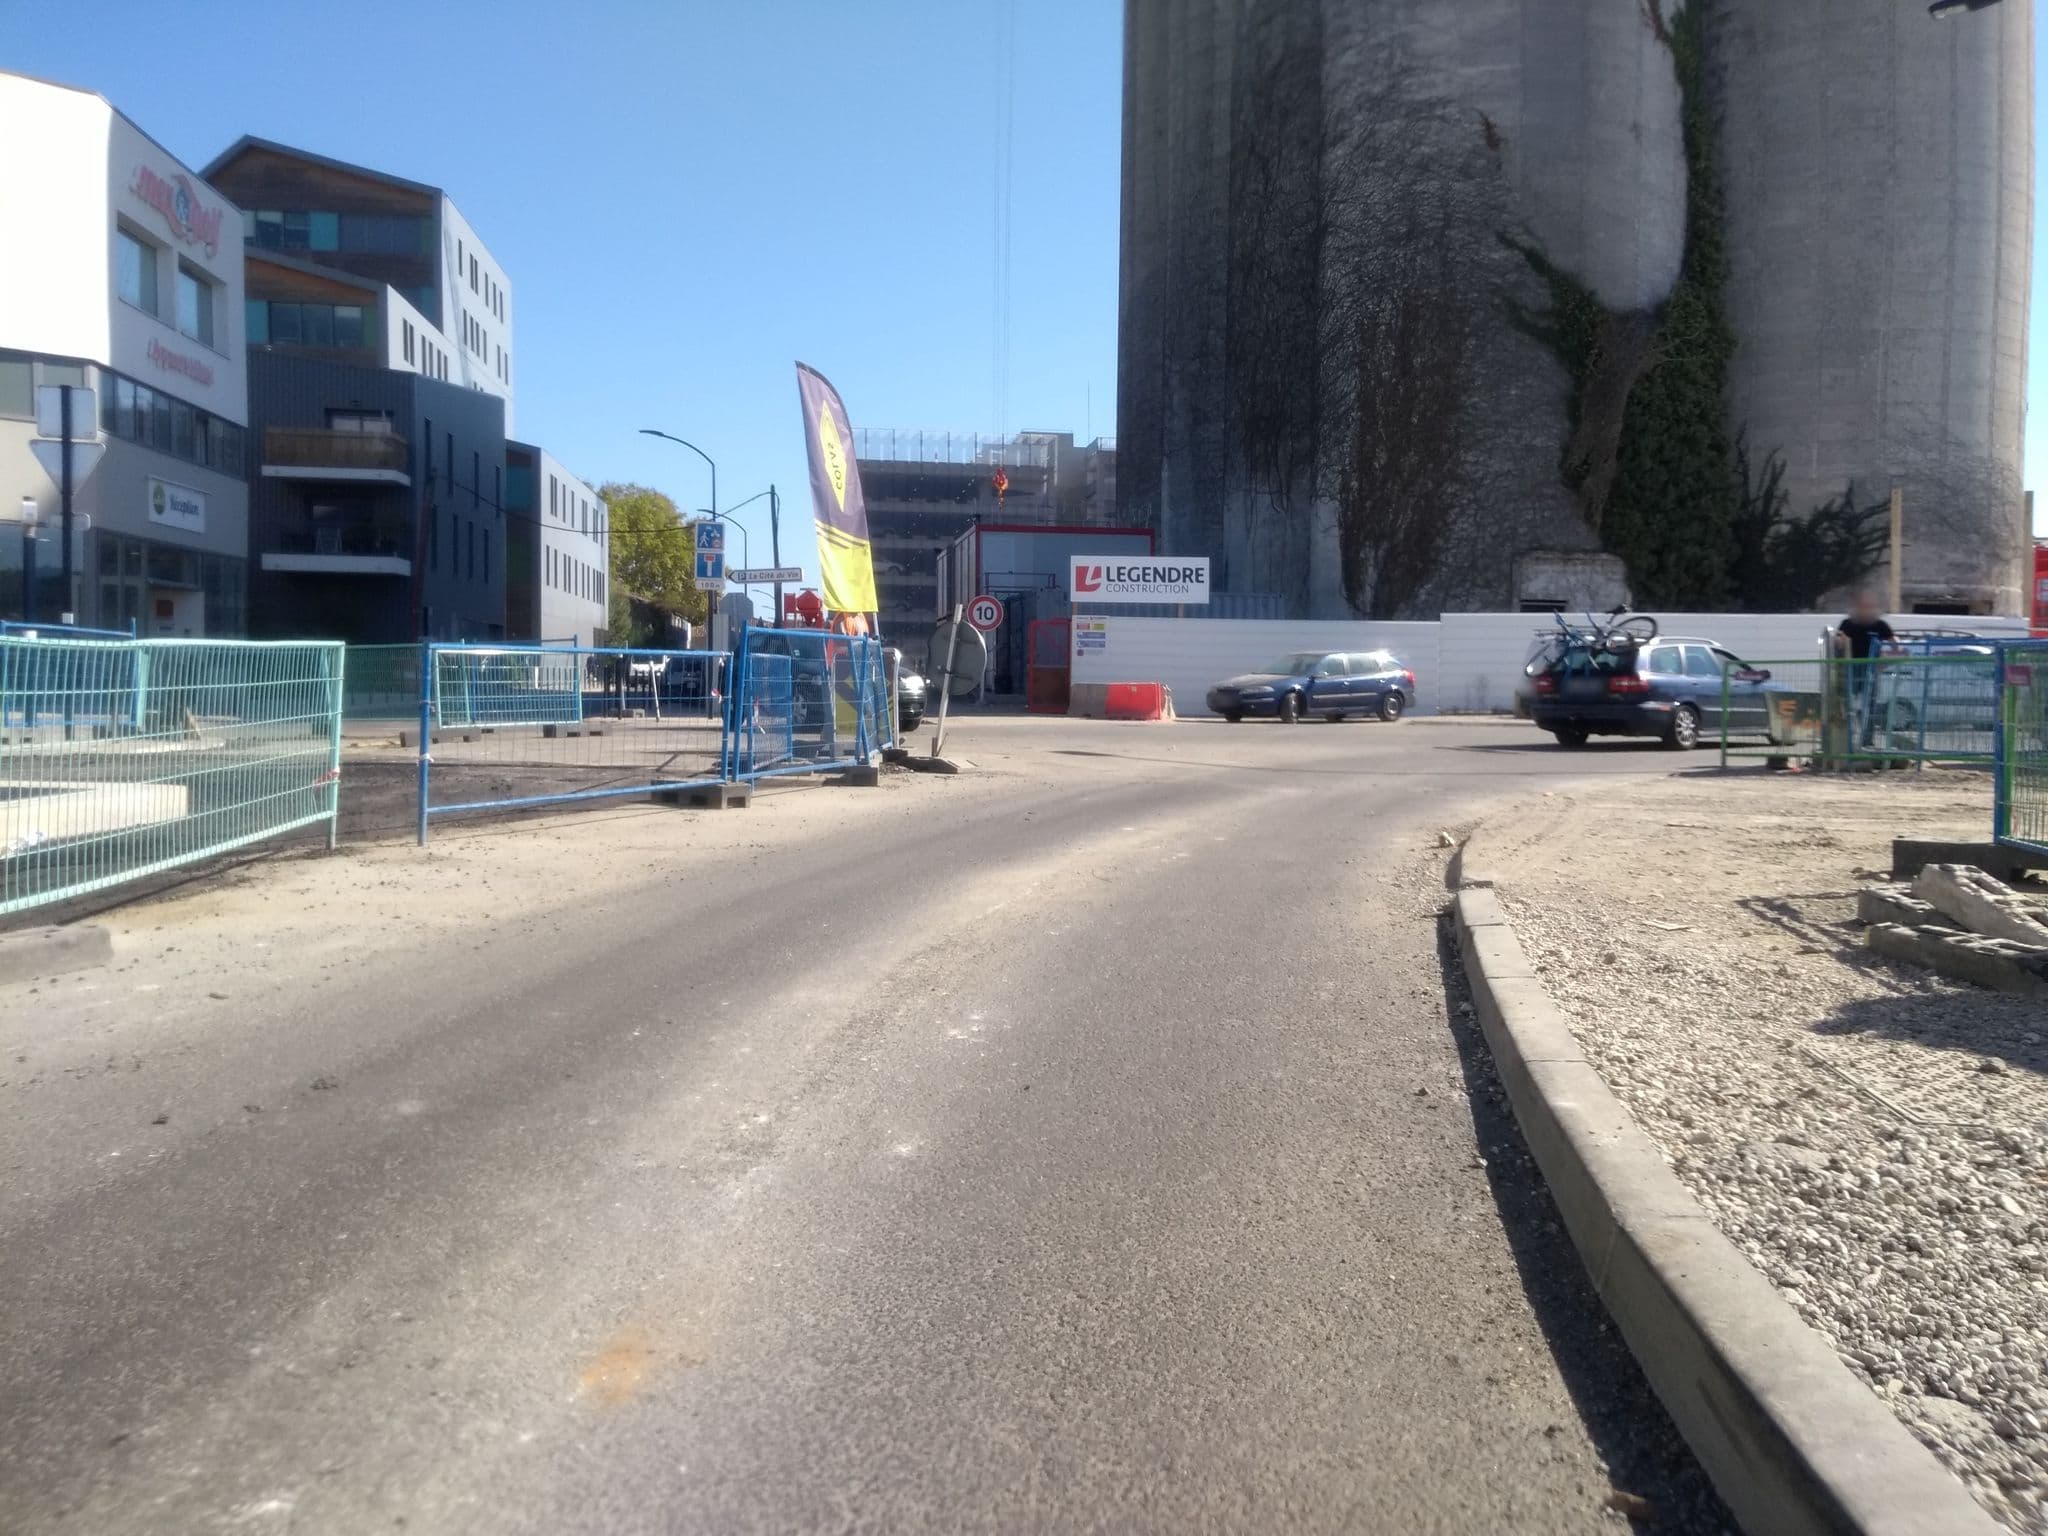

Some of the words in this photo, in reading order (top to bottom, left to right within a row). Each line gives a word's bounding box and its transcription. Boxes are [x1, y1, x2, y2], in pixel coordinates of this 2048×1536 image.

[1106, 566, 1205, 583] LEGENDRE
[1106, 583, 1190, 593] CONSTRUCTION
[976, 606, 994, 620] 10
